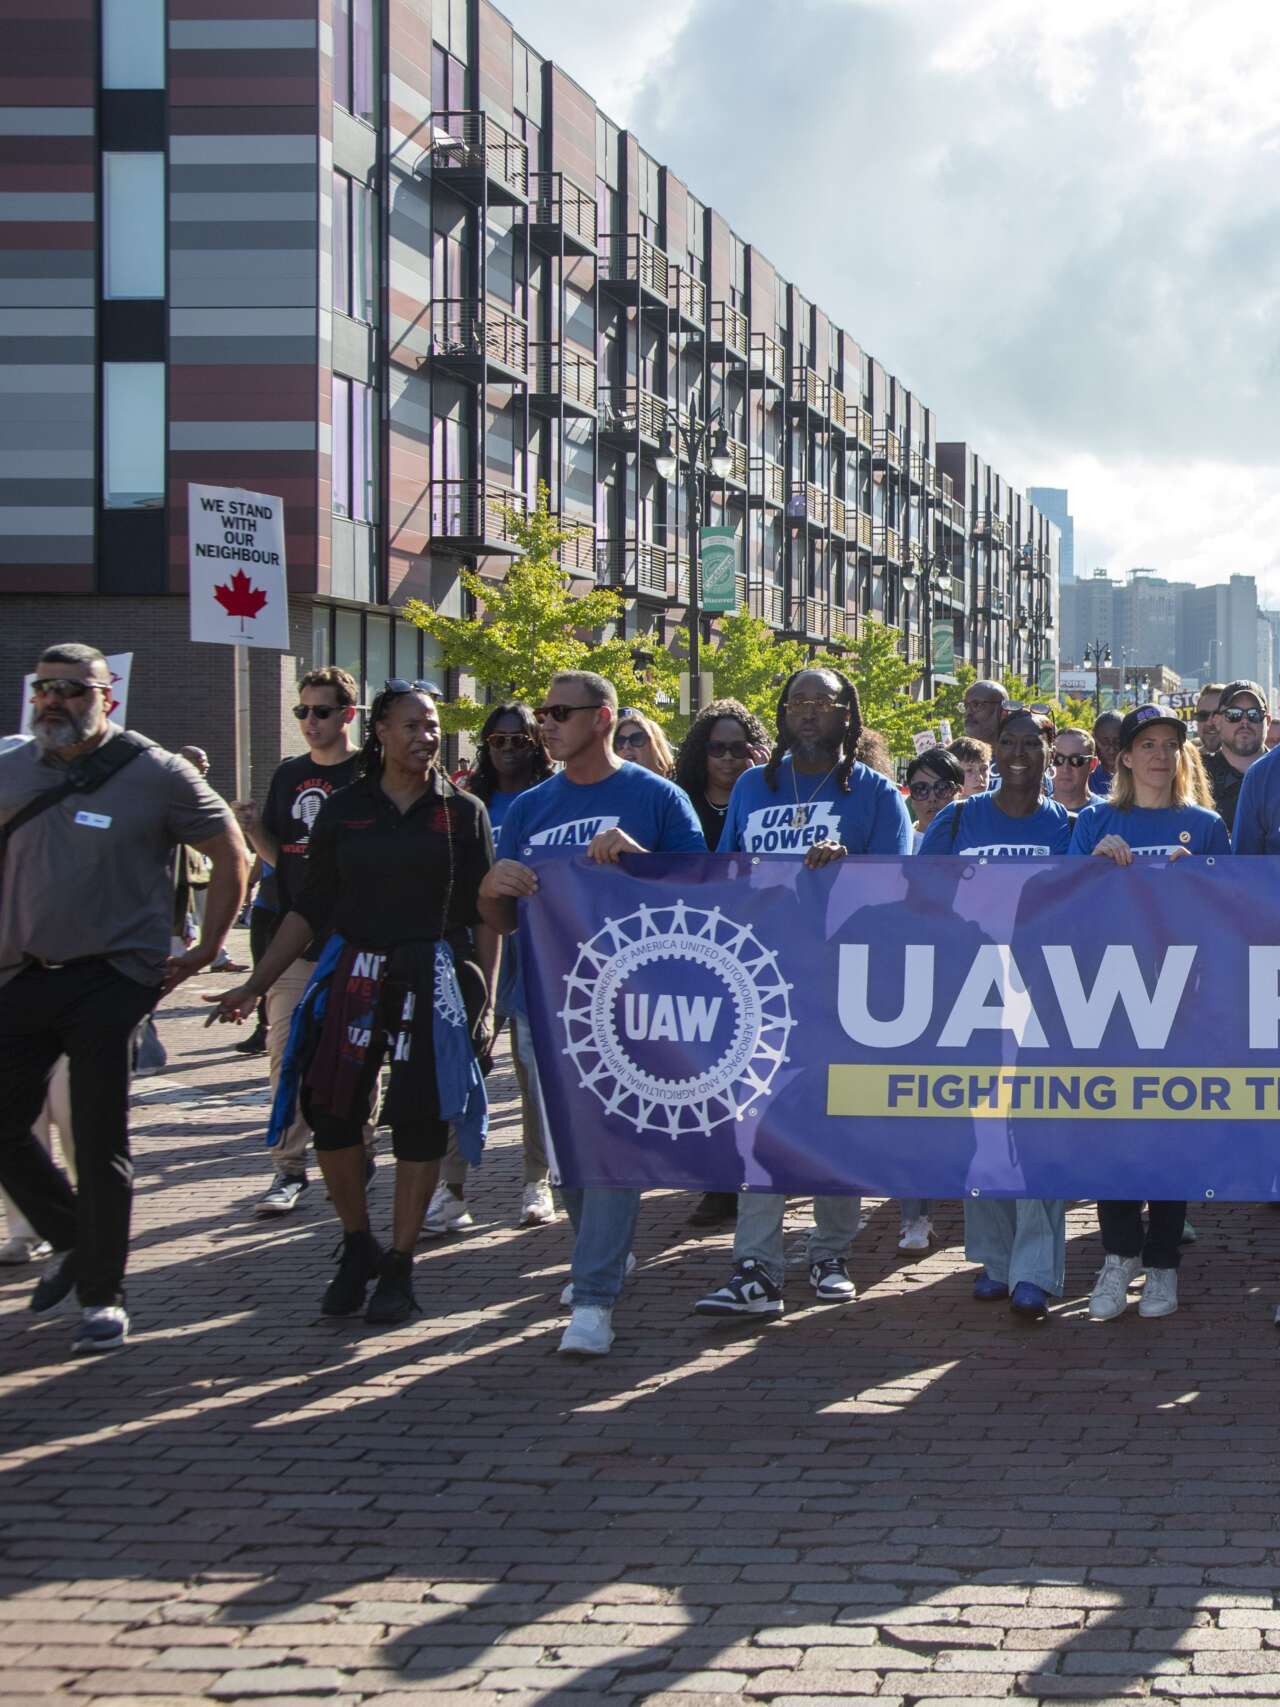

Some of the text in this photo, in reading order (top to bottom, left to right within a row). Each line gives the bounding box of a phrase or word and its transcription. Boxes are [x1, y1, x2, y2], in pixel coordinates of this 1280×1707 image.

[201, 497, 273, 520] WE STAND
[221, 515, 257, 532] WITH
[224, 531, 254, 547] OUR
[196, 543, 280, 566] NEIGHBOUR
[630, 940, 677, 958] AMERICA
[681, 940, 720, 959] UNITED
[595, 967, 617, 1015] WORKERS
[837, 943, 1198, 1049] UAW
[625, 993, 723, 1042] UAW
[698, 1076, 719, 1094] AND
[888, 1073, 1117, 1110] FIGHTING
[1133, 1076, 1231, 1111] FOR
